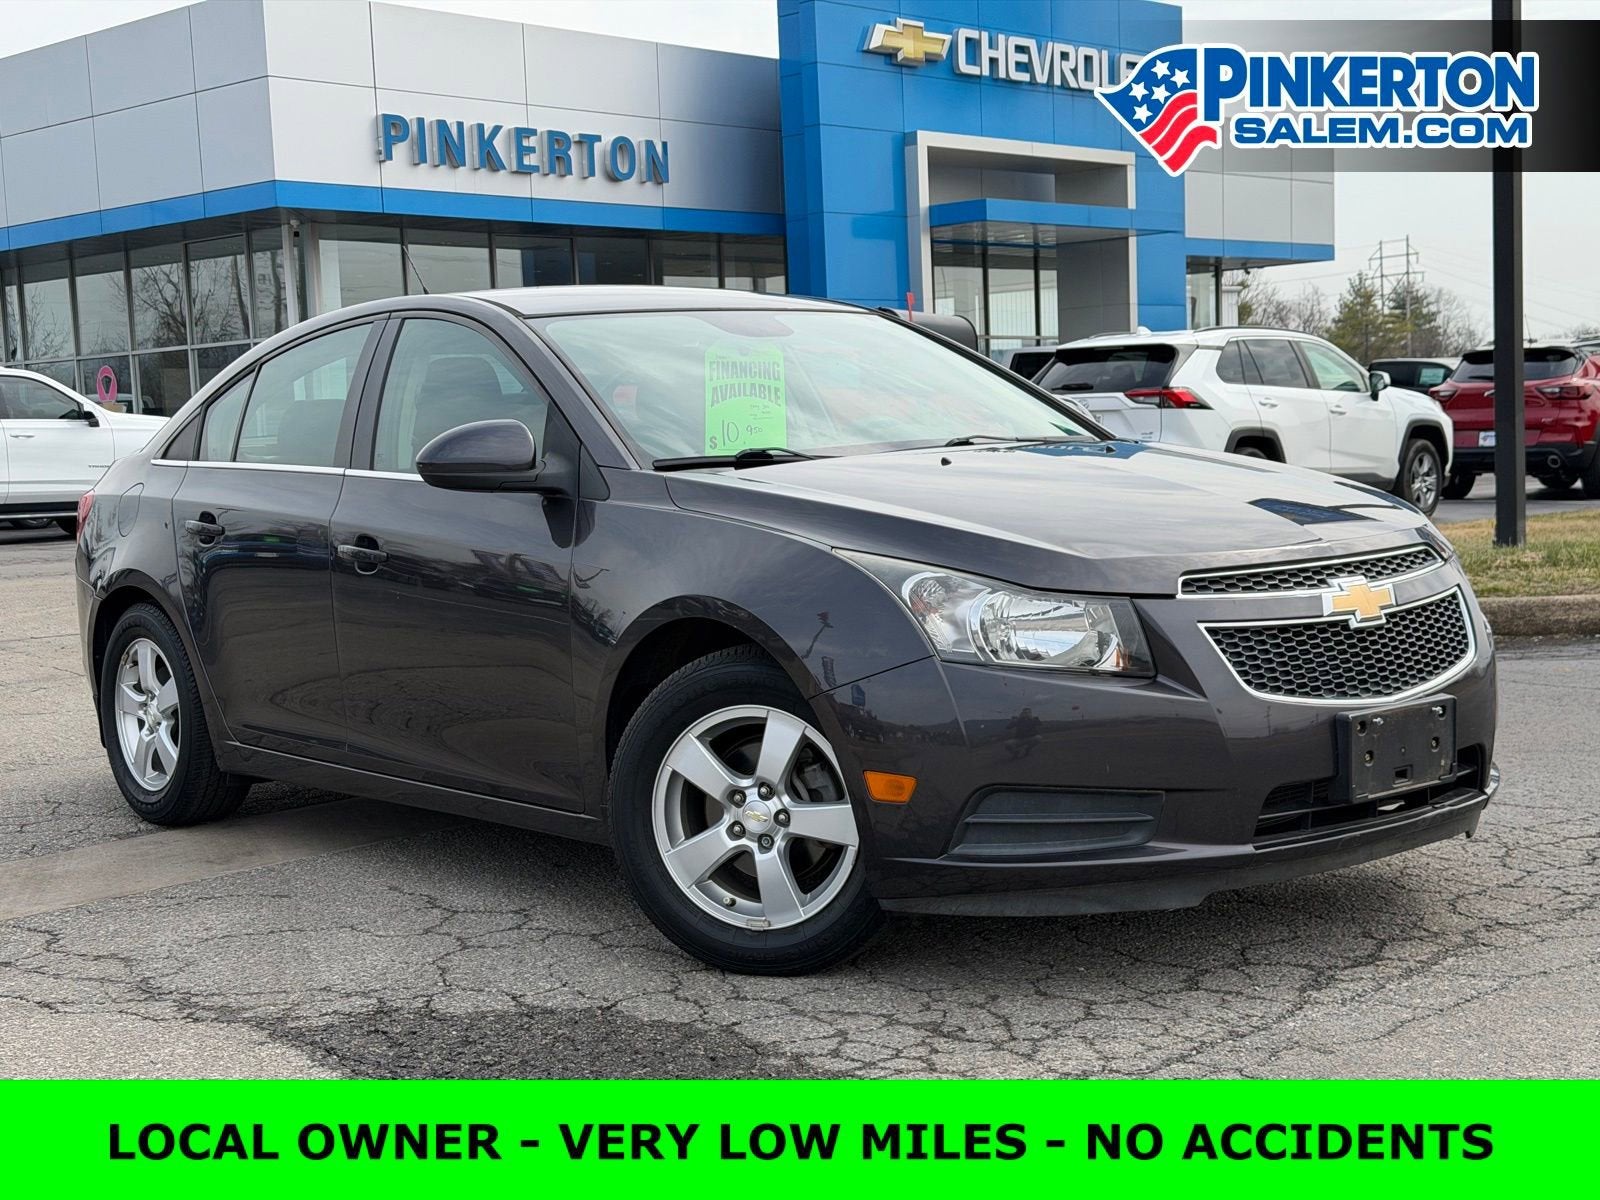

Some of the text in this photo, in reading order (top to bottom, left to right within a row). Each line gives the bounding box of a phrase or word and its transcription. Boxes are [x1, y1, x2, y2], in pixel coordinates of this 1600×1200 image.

[378, 113, 670, 184] PINKERTON
[709, 360, 781, 381] FINANCING
[711, 383, 781, 408] AVAILABLE
